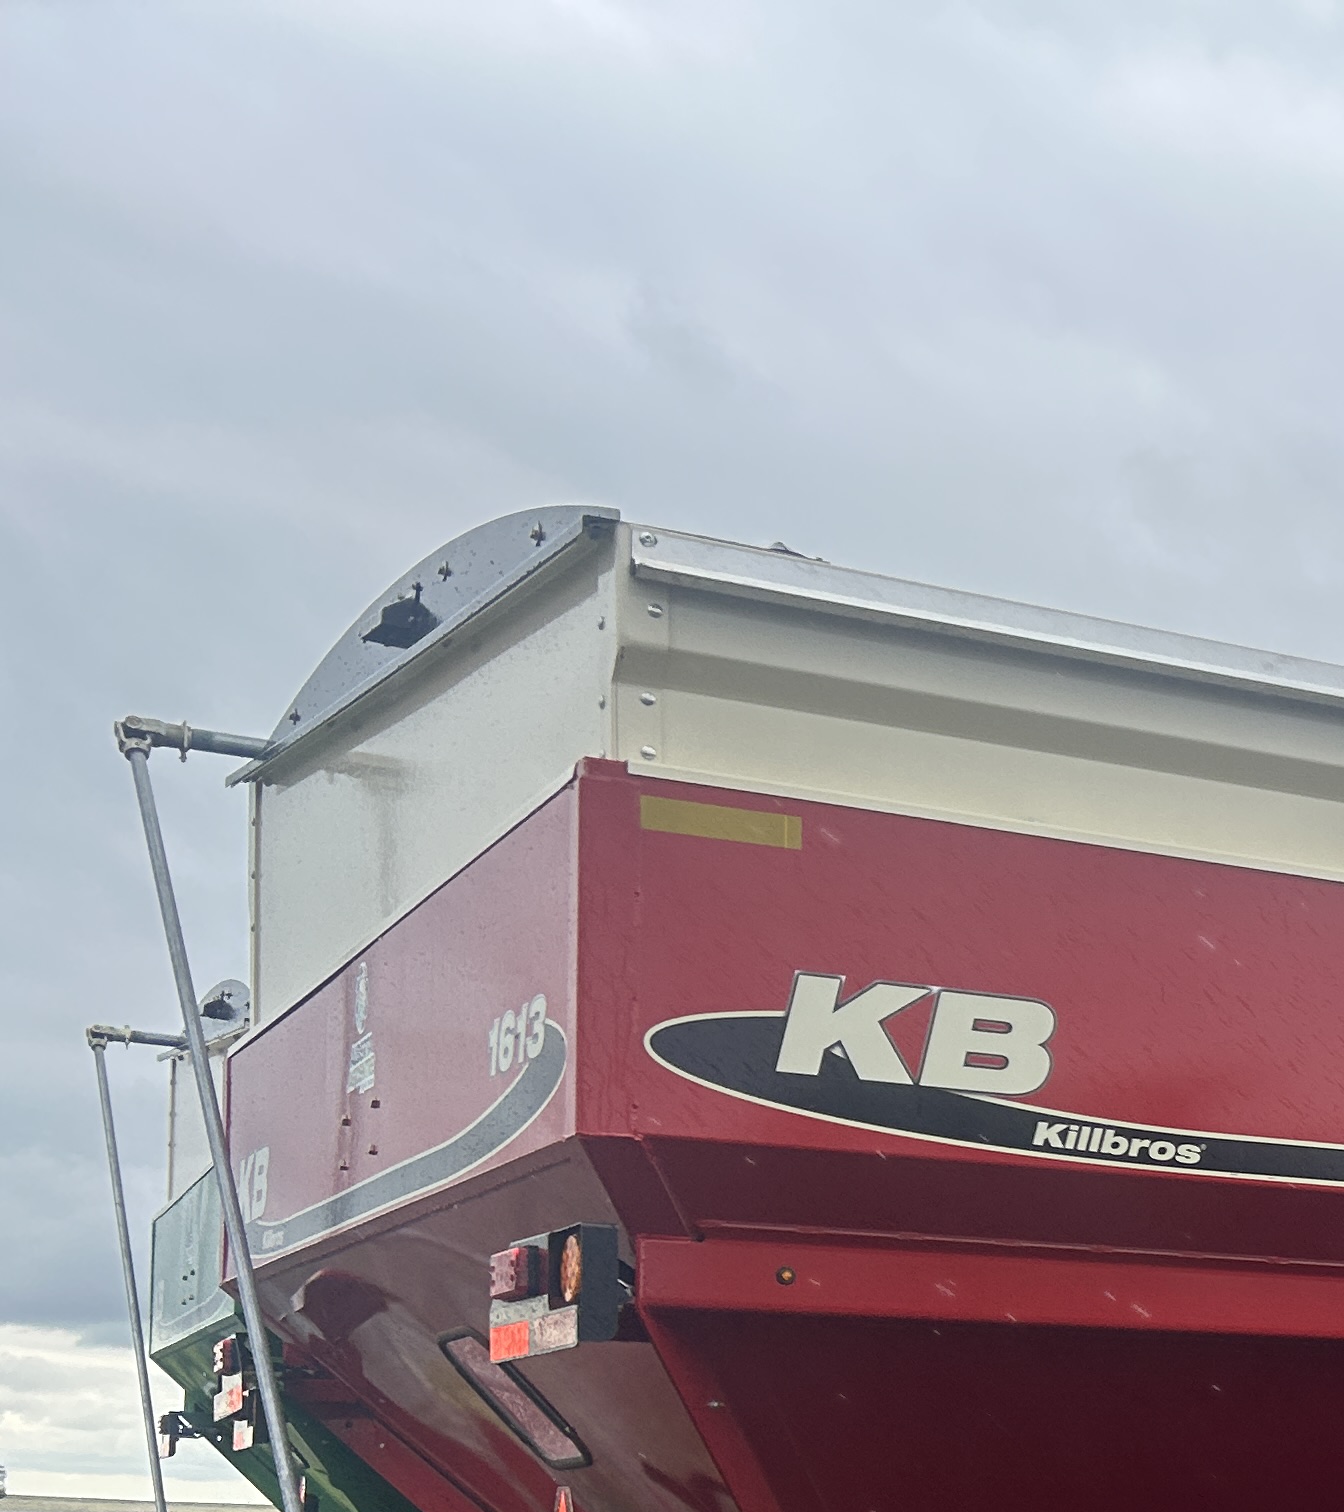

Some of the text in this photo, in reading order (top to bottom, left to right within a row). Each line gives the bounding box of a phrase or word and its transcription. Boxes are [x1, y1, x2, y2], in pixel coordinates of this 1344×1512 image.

[488, 993, 547, 1077] 1613
[775, 970, 1055, 1095] KB
[1032, 1121, 1202, 1165] Killbros
